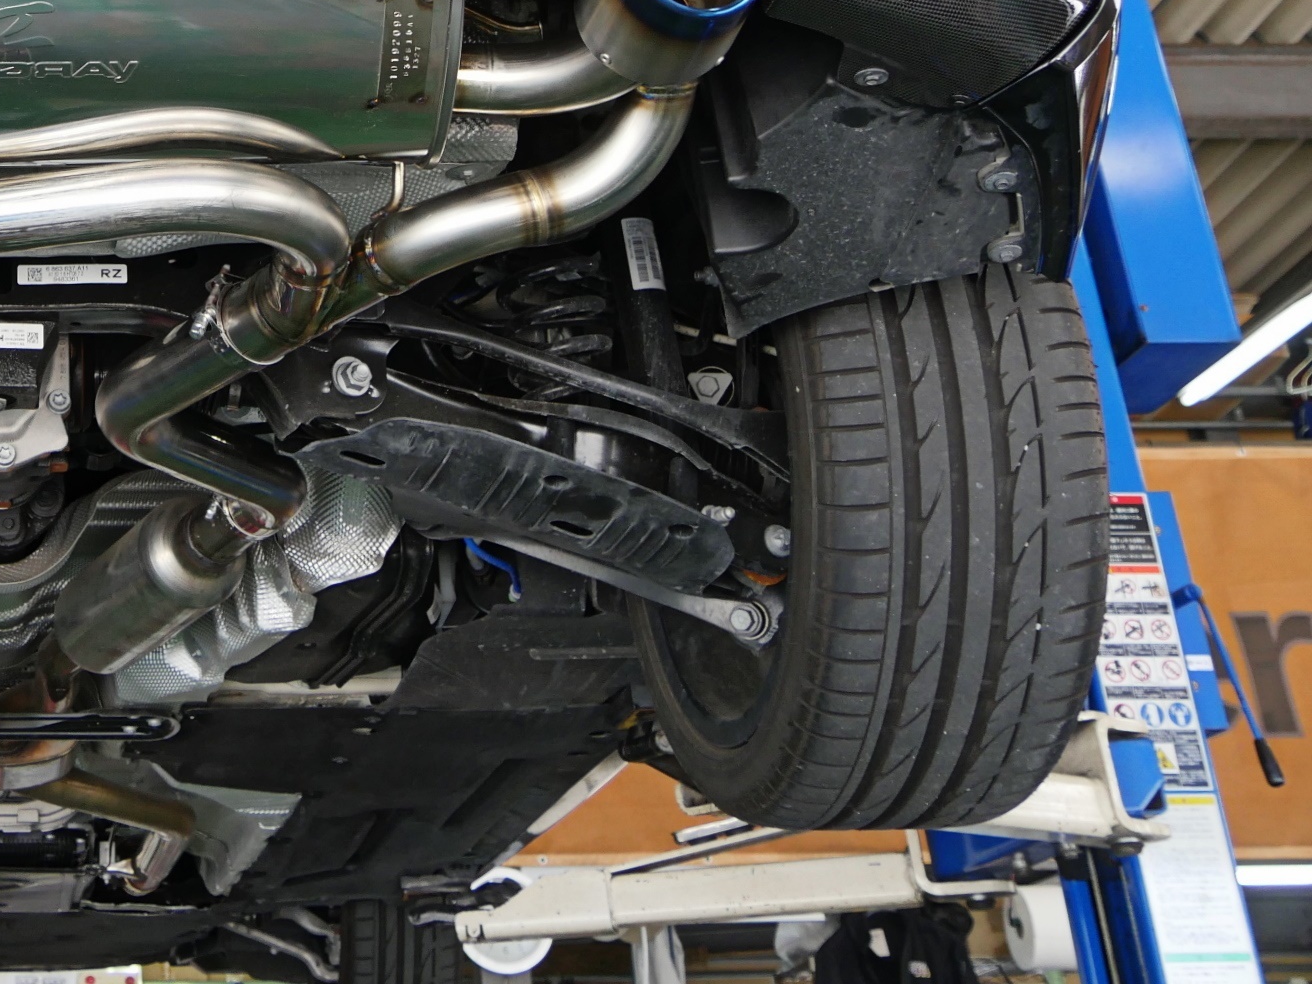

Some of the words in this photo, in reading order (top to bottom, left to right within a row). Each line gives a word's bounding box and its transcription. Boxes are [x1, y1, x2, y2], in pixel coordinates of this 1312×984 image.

[389, 11, 402, 79] 10192099
[412, 47, 421, 69] 1327
[100, 269, 122, 278] RZ
